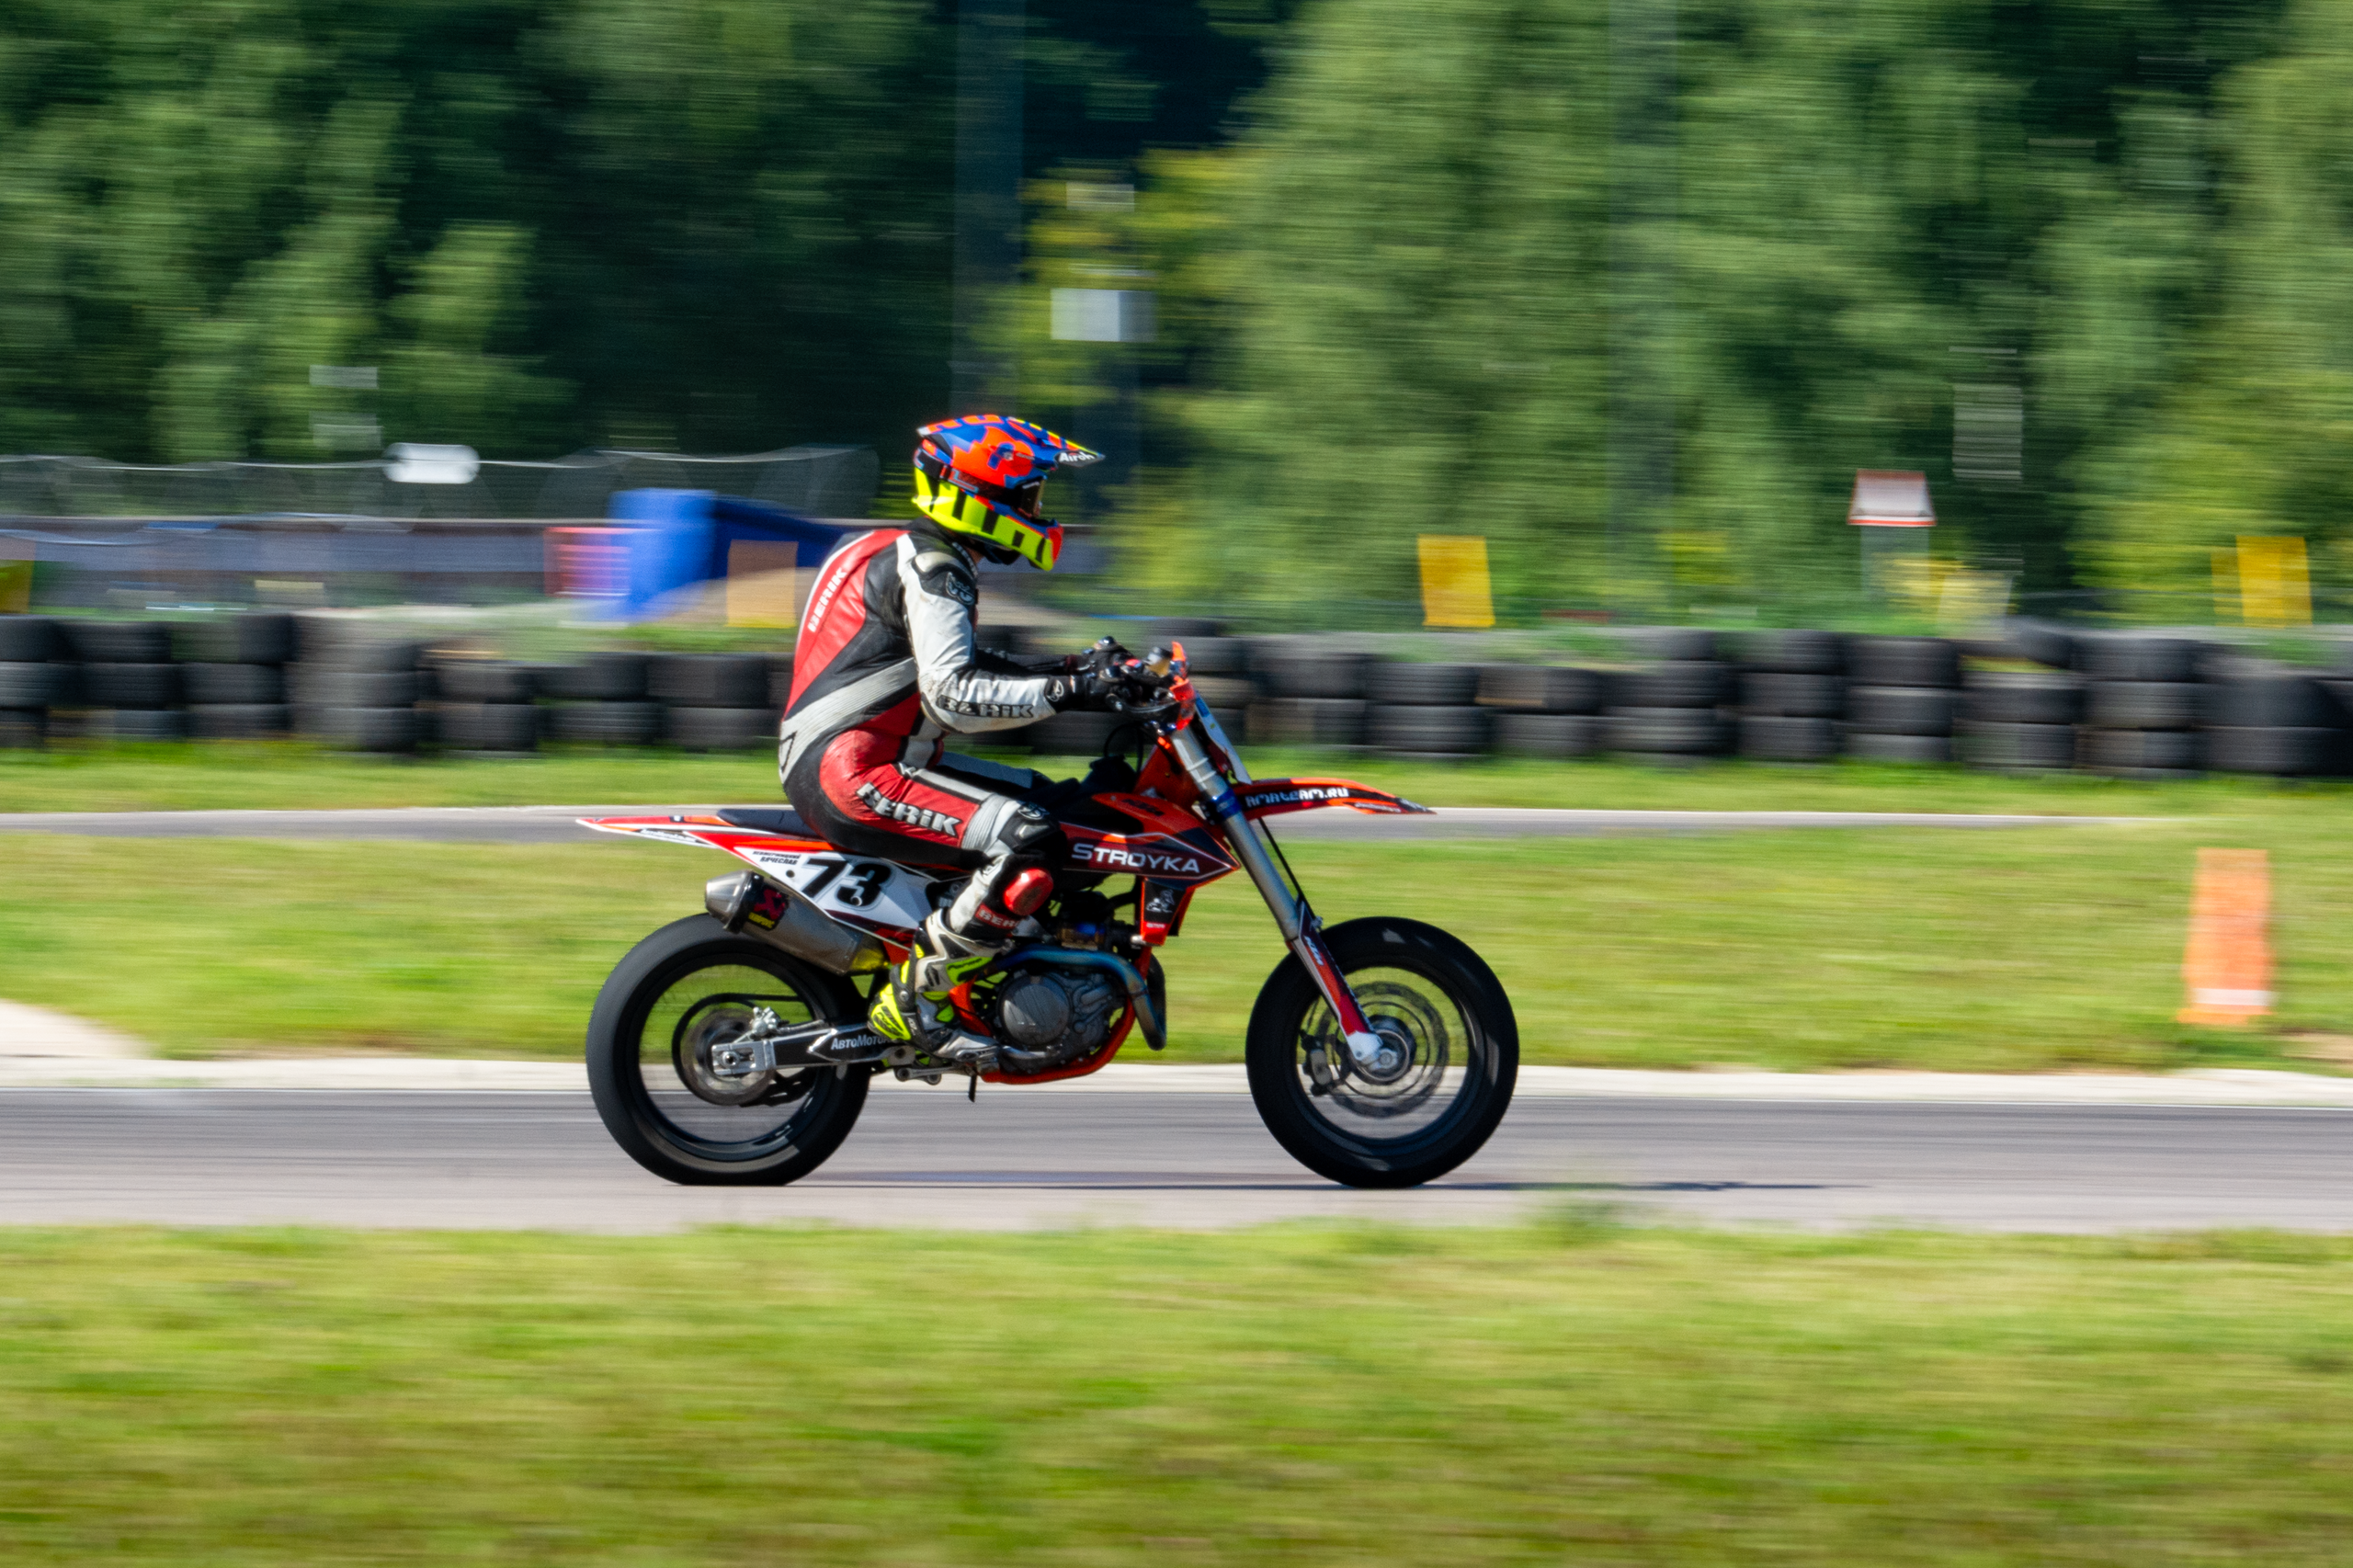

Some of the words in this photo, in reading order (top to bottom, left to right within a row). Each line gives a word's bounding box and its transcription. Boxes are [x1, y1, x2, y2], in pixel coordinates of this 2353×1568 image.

[1059, 451, 1096, 462] Airoh
[1071, 842, 1200, 873] STROYKA
[801, 857, 892, 907] 73
